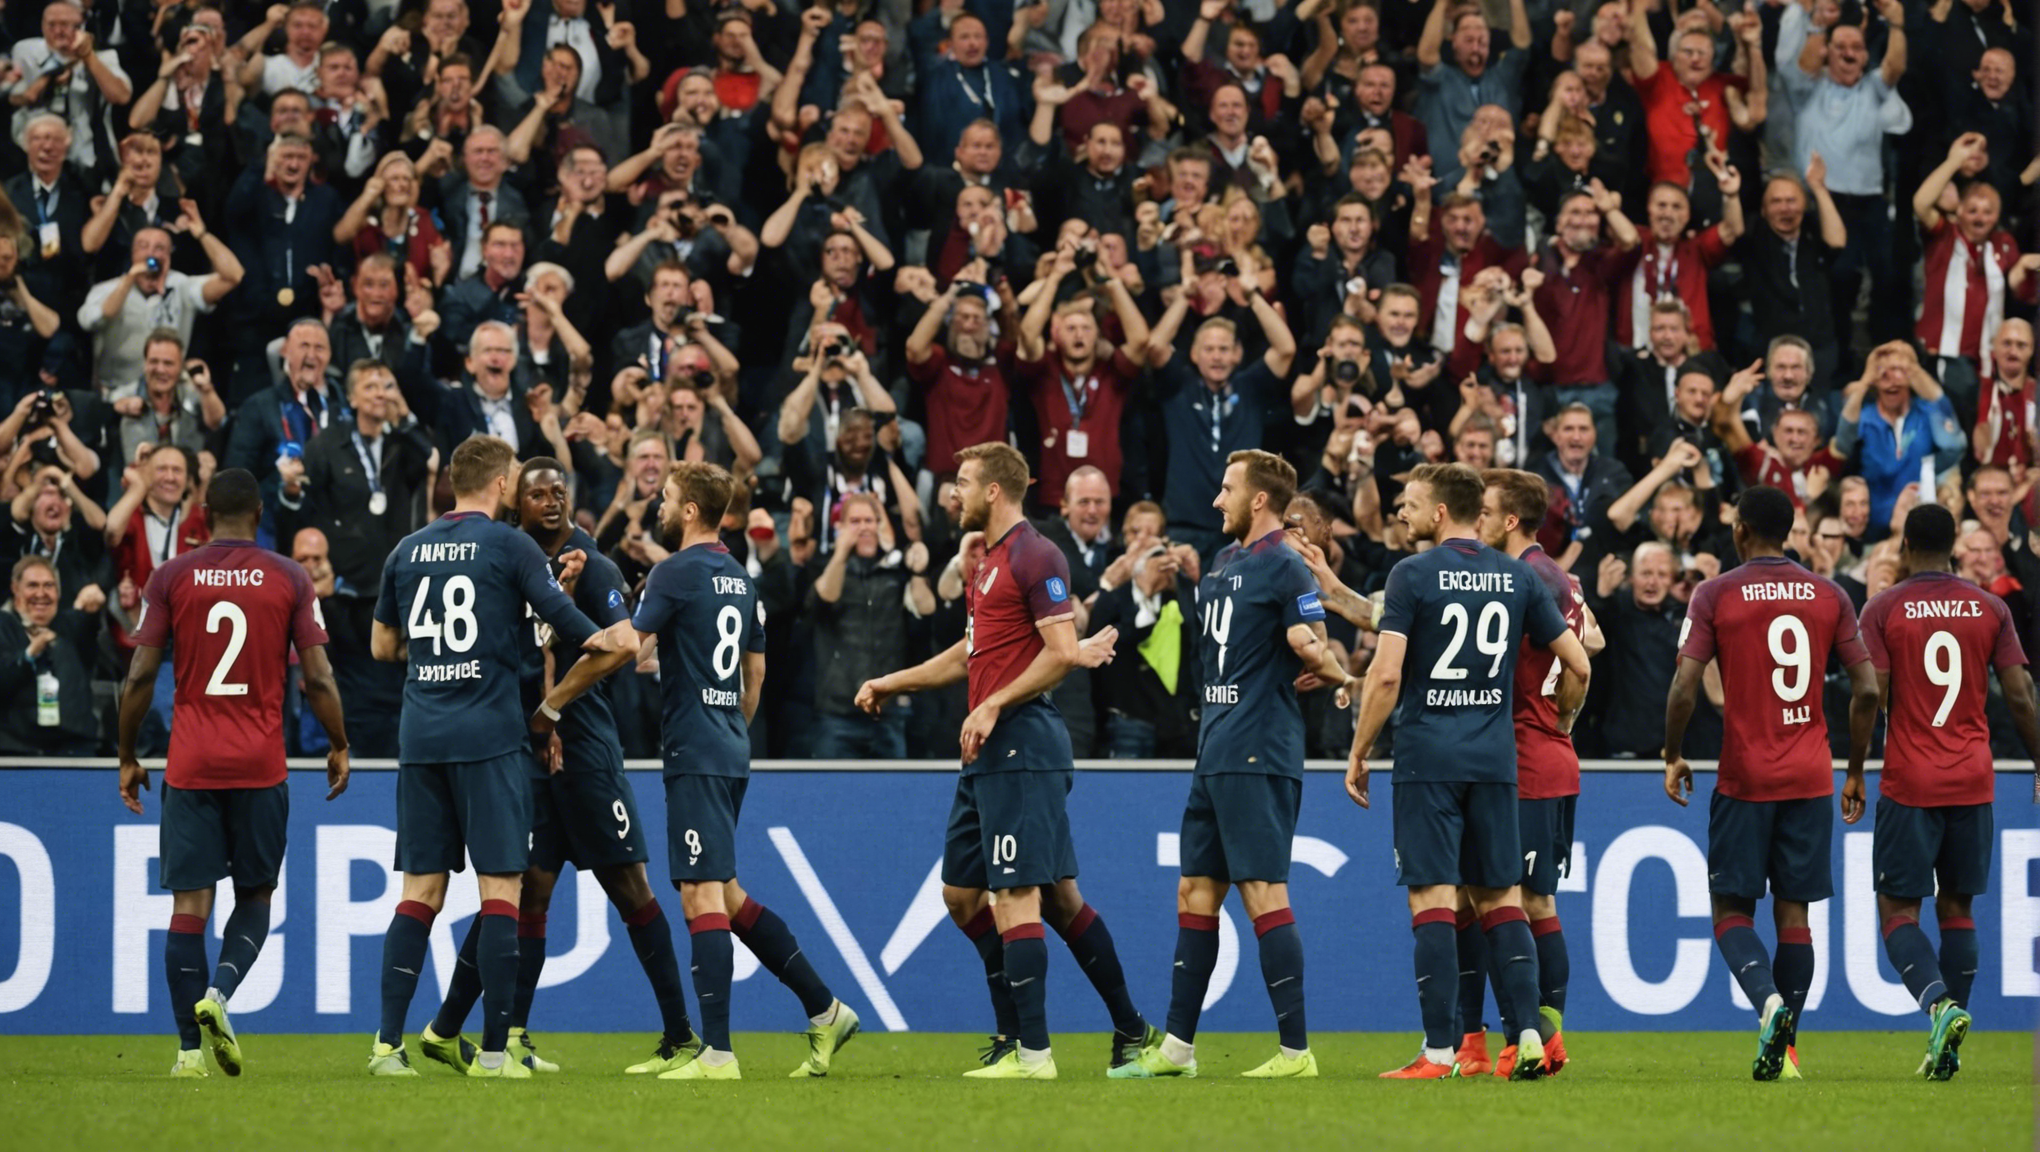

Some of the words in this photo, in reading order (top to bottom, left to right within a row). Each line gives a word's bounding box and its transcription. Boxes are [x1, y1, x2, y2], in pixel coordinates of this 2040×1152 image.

[205, 600, 249, 696] 2
[407, 574, 479, 656] 48
[712, 604, 743, 681] 8
[1429, 600, 1510, 680] 29
[1767, 614, 1811, 702] 9
[1923, 630, 1963, 727] 9
[612, 799, 630, 840] 9
[684, 828, 703, 857] 8
[992, 834, 1017, 866] 10
